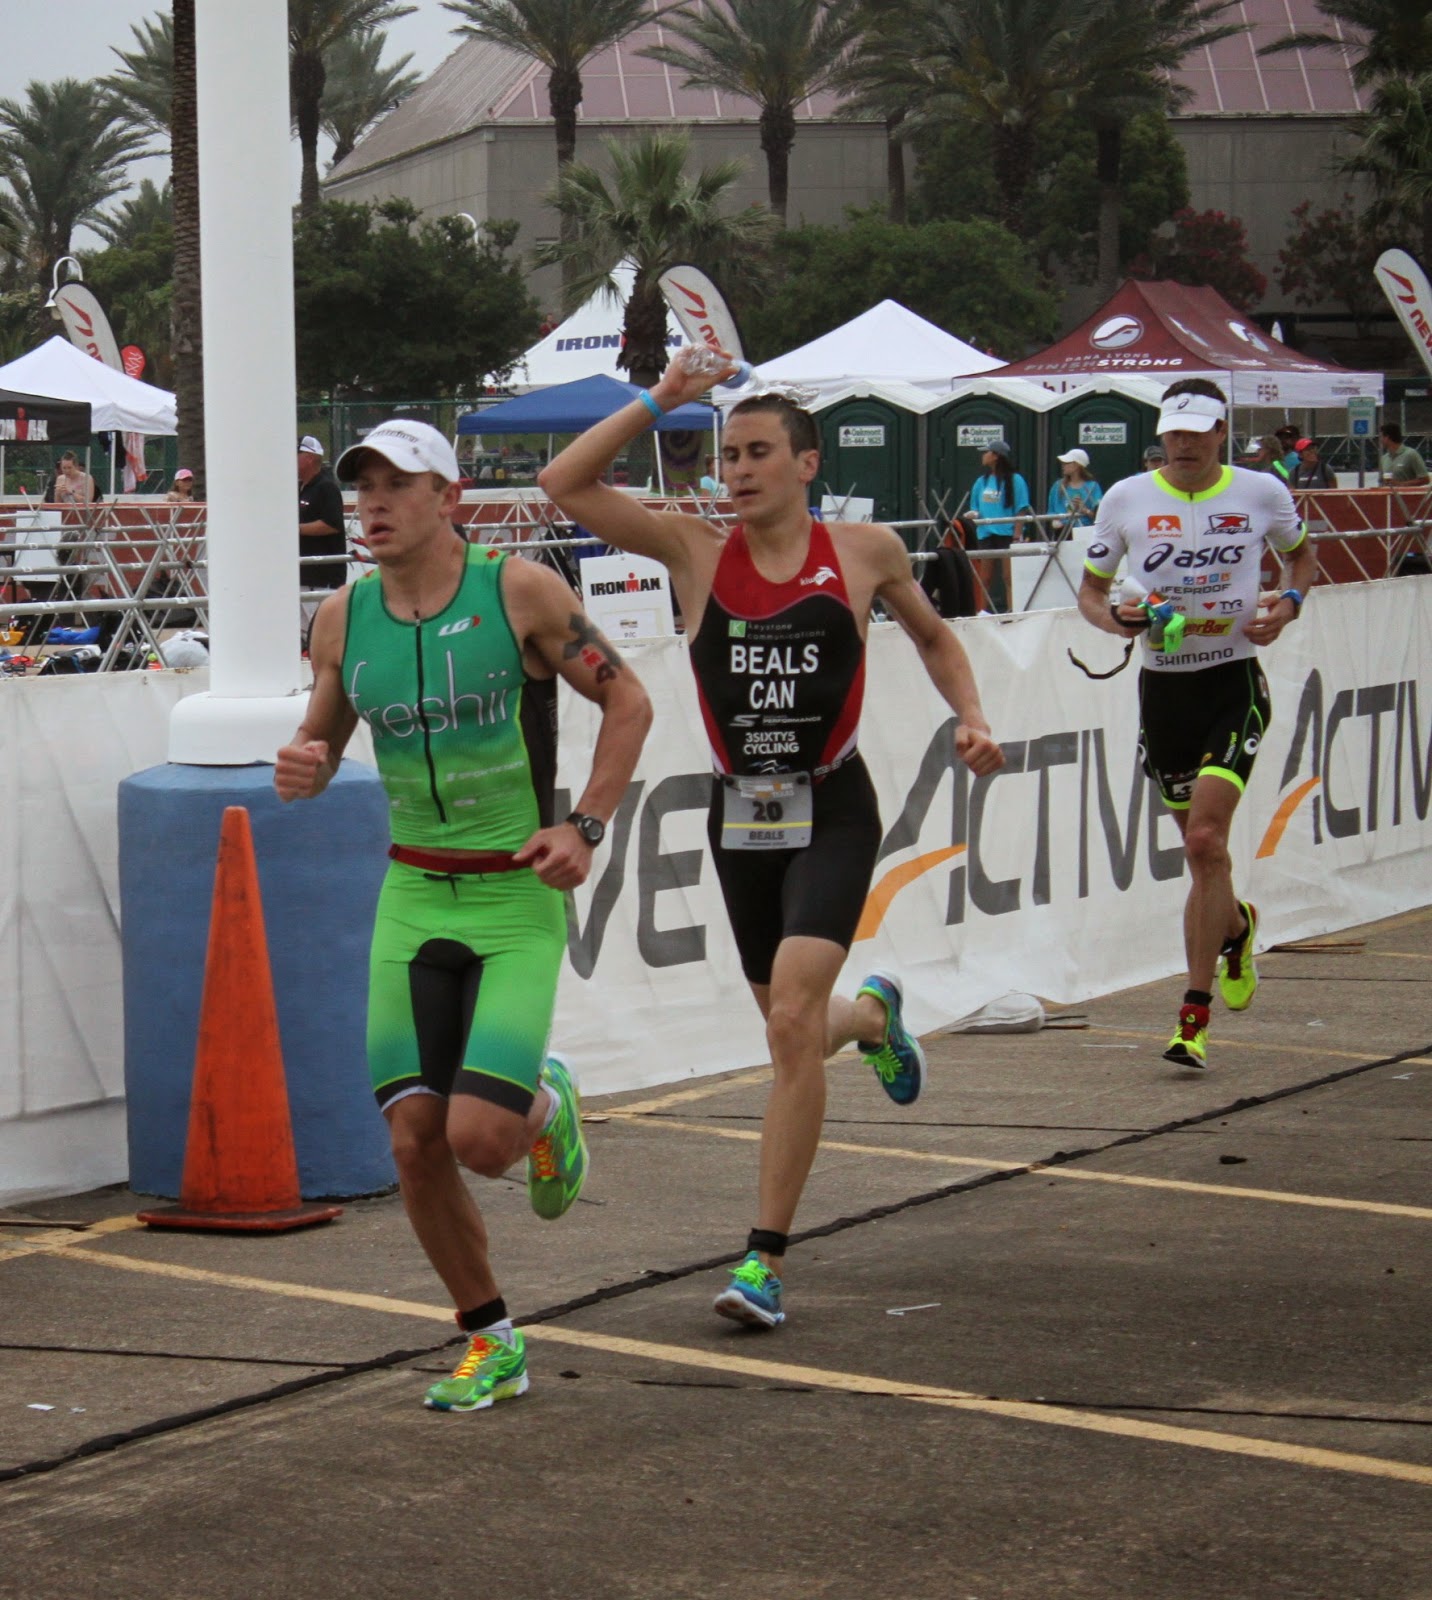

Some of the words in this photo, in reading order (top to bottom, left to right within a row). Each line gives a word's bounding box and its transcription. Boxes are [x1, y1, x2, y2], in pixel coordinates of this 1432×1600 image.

[556, 334, 684, 351] IRONN
[1065, 354, 1100, 362] DANA
[851, 428, 881, 436] Oakmont
[970, 427, 1001, 436] Oakmont
[1092, 425, 1123, 433] Oakmont
[590, 573, 662, 596] IRONMAN
[1153, 584, 1232, 595] LIFEPROOF
[1220, 599, 1243, 609] TYR
[730, 644, 820, 675] BEALS
[1155, 647, 1234, 666] SHIMANO
[348, 650, 508, 738] freshii
[750, 680, 795, 709] CAN
[745, 731, 796, 743] 3SIXTY5
[743, 742, 800, 755] CYCLING
[752, 801, 784, 822] 20
[749, 831, 785, 841] BEALS
